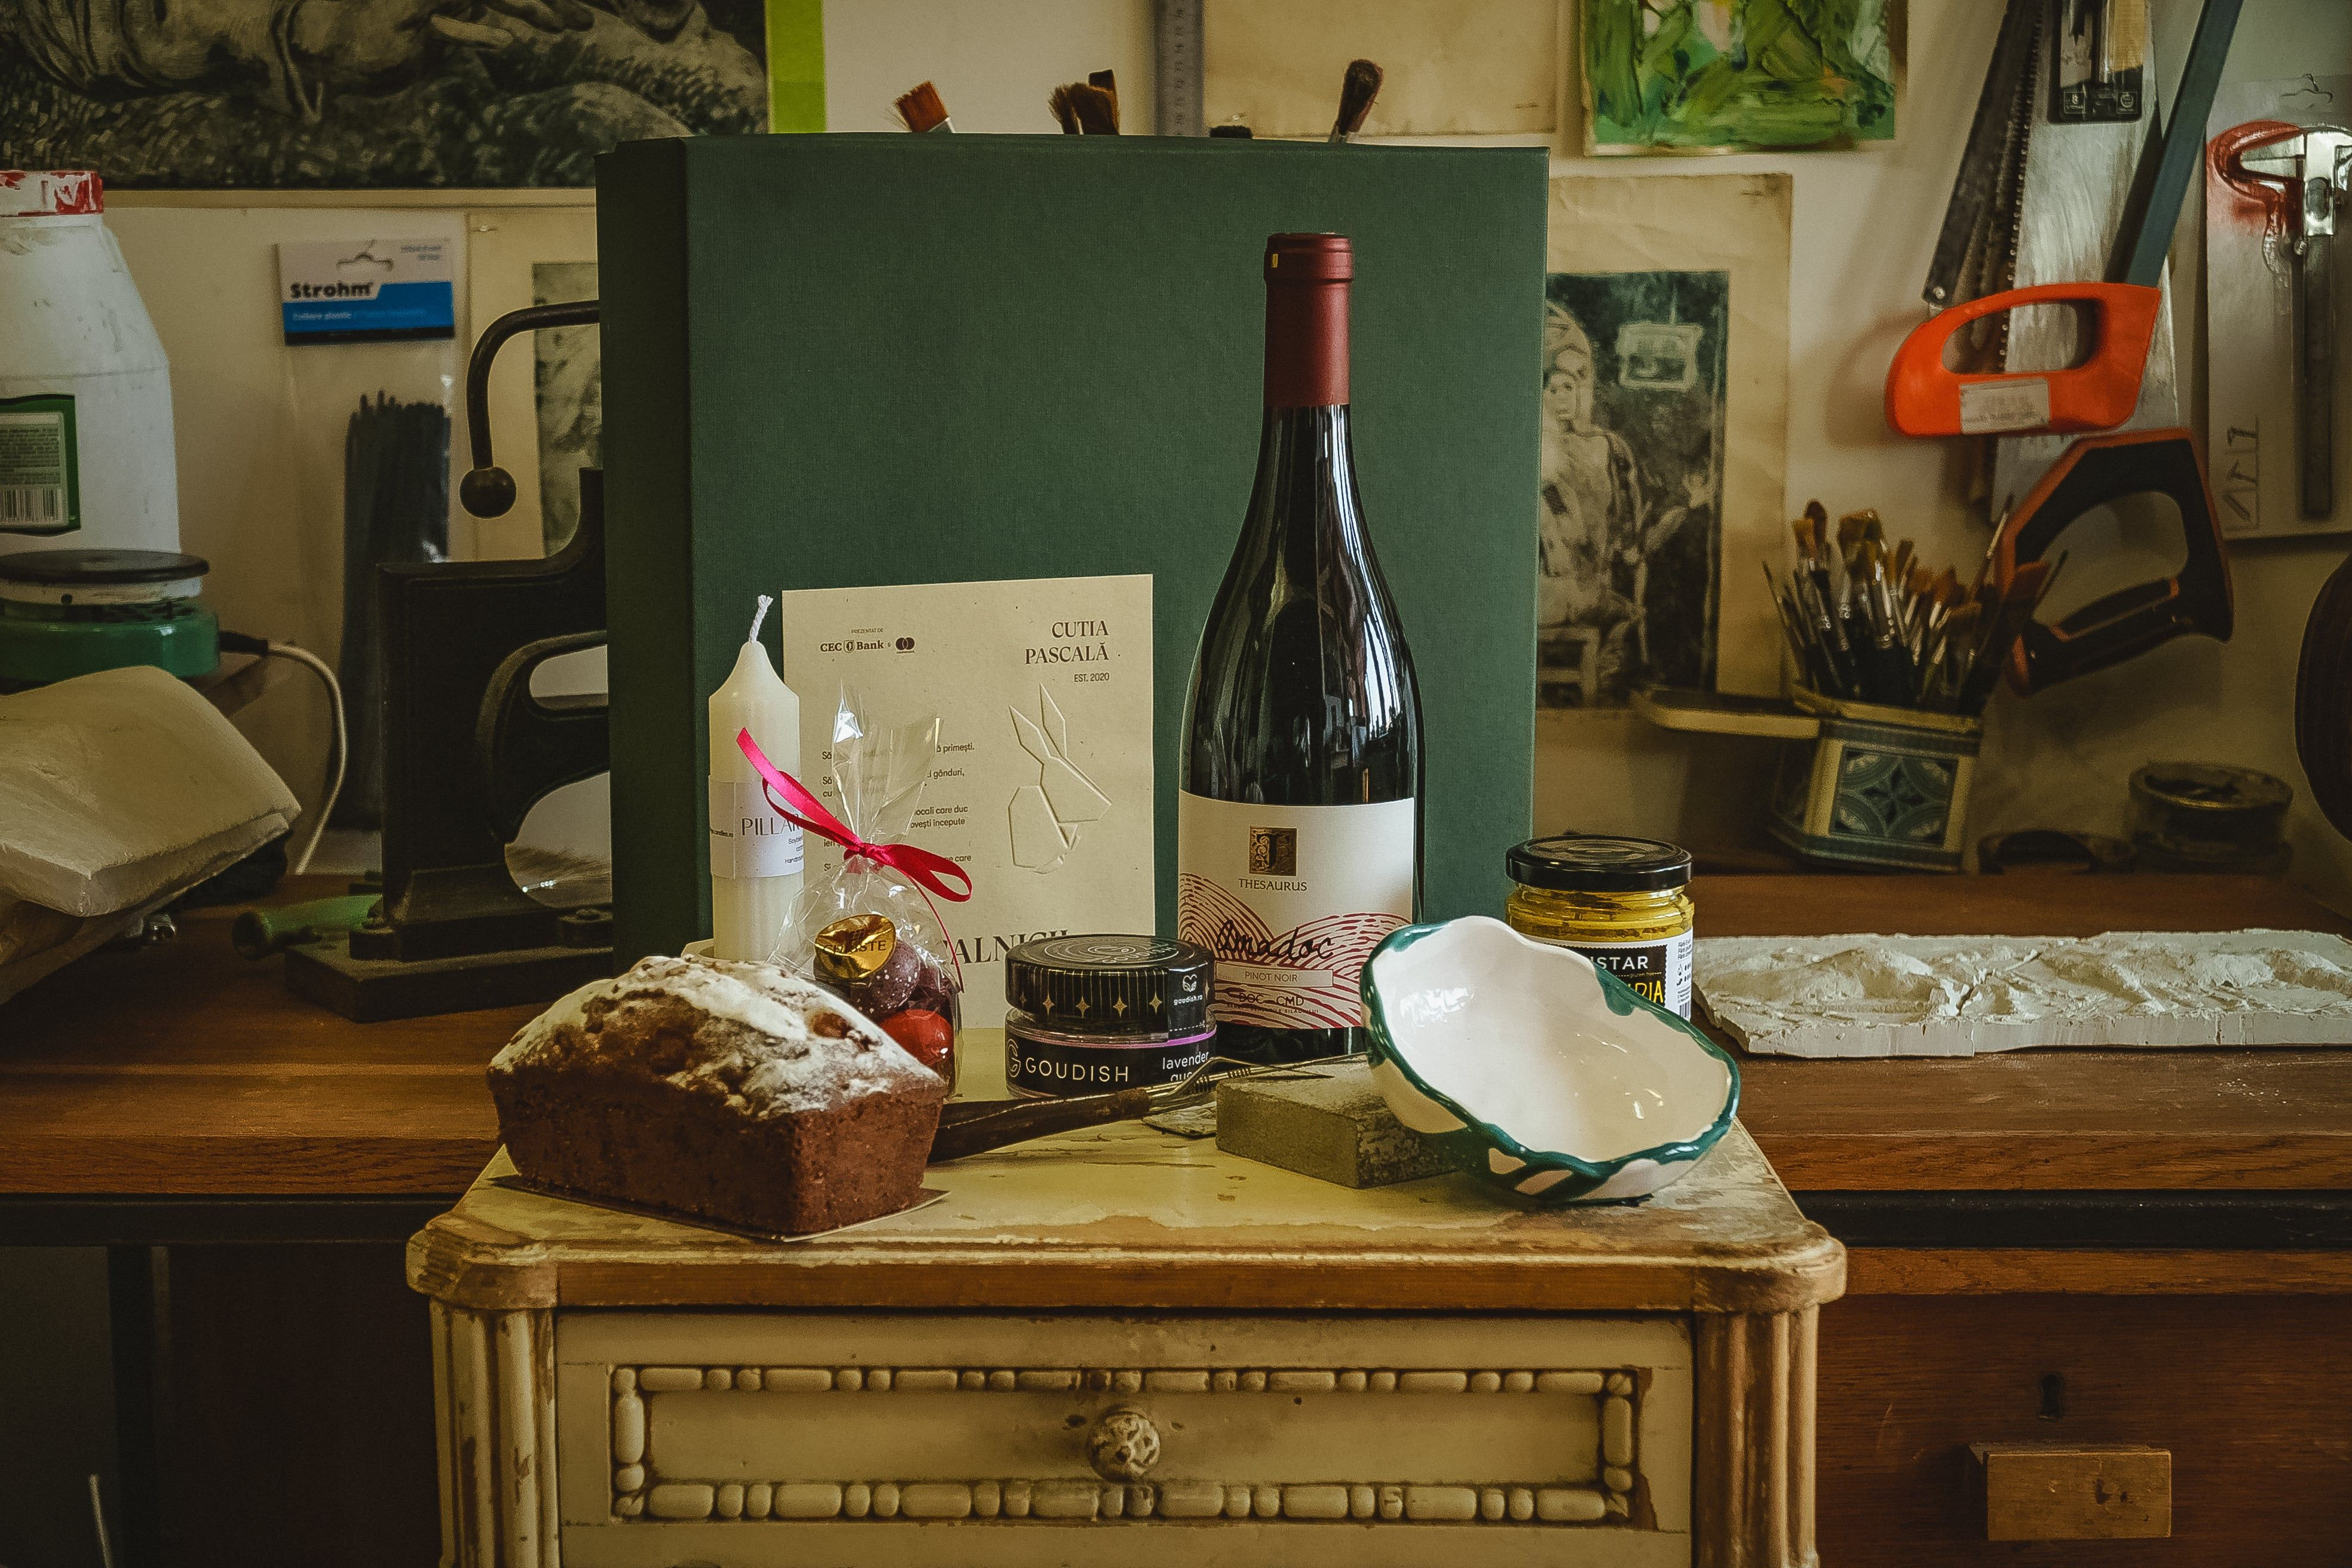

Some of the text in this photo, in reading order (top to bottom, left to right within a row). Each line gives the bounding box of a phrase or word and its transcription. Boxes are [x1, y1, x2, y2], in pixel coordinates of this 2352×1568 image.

[290, 281, 371, 298] Strohm
[1052, 620, 1109, 638] CUTIA
[820, 642, 843, 653] CEC
[856, 640, 885, 651] Bank
[1025, 641, 1110, 664] PASCALĂ
[1074, 672, 1110, 682] EST. 2020
[954, 804, 969, 813] duc
[910, 819, 932, 829] ovești
[1238, 878, 1307, 892] THESAURUS
[1591, 956, 1649, 970] STAR
[1245, 971, 1272, 982] PINOT
[1274, 973, 1298, 982] NOIR
[1238, 992, 1304, 1006] DOC CMD
[1162, 1051, 1209, 1070] lavender
[1025, 1057, 1129, 1083] GOUDISH
